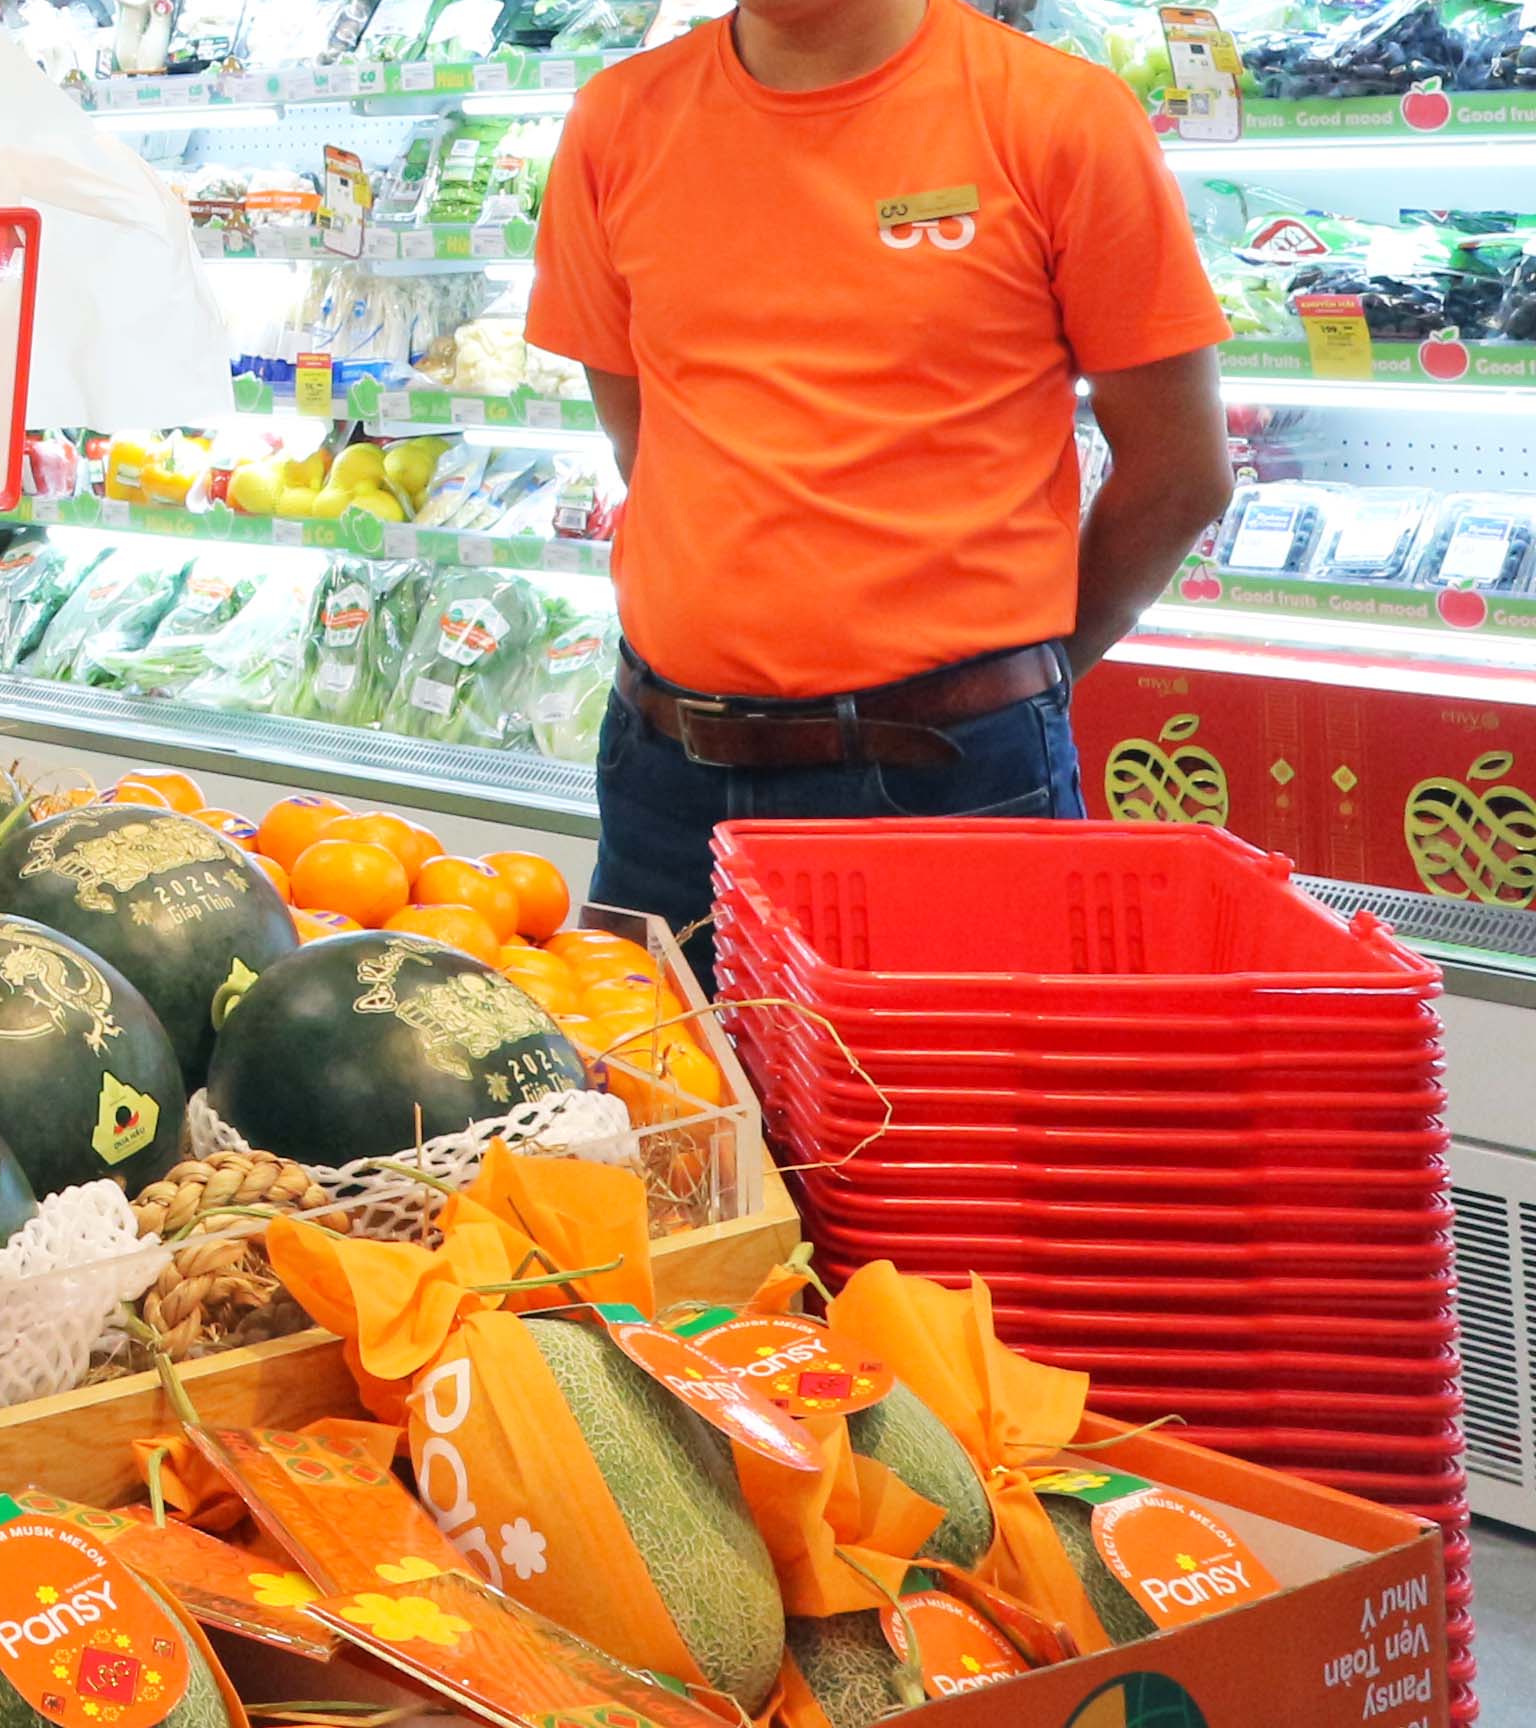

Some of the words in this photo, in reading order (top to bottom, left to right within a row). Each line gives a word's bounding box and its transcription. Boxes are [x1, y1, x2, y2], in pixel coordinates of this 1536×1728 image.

[1296, 111, 1340, 128] Good
[1344, 110, 1393, 125] mood
[1457, 107, 1504, 123] Good
[1217, 352, 1259, 368] Good
[1262, 354, 1300, 369] fruits
[1476, 358, 1525, 376] Good
[1231, 587, 1274, 604] Good
[1278, 590, 1317, 609] fruits
[1329, 596, 1375, 613] Good
[1379, 602, 1427, 617] mood
[153, 872, 221, 905] 2024
[167, 900, 202, 924] Giáp
[1143, 1498, 1186, 1515] MUSK
[1188, 1510, 1238, 1549] MELON
[9, 1526, 55, 1538] MUSK
[59, 1531, 107, 1568] MELON
[1139, 1560, 1252, 1614] Pansy
[1380, 1574, 1428, 1620] Như
[1360, 1597, 1376, 1640] Ý
[1385, 1619, 1429, 1661] Vẹn
[1324, 1643, 1380, 1688] Toàn
[1363, 1668, 1430, 1720] Pansy
